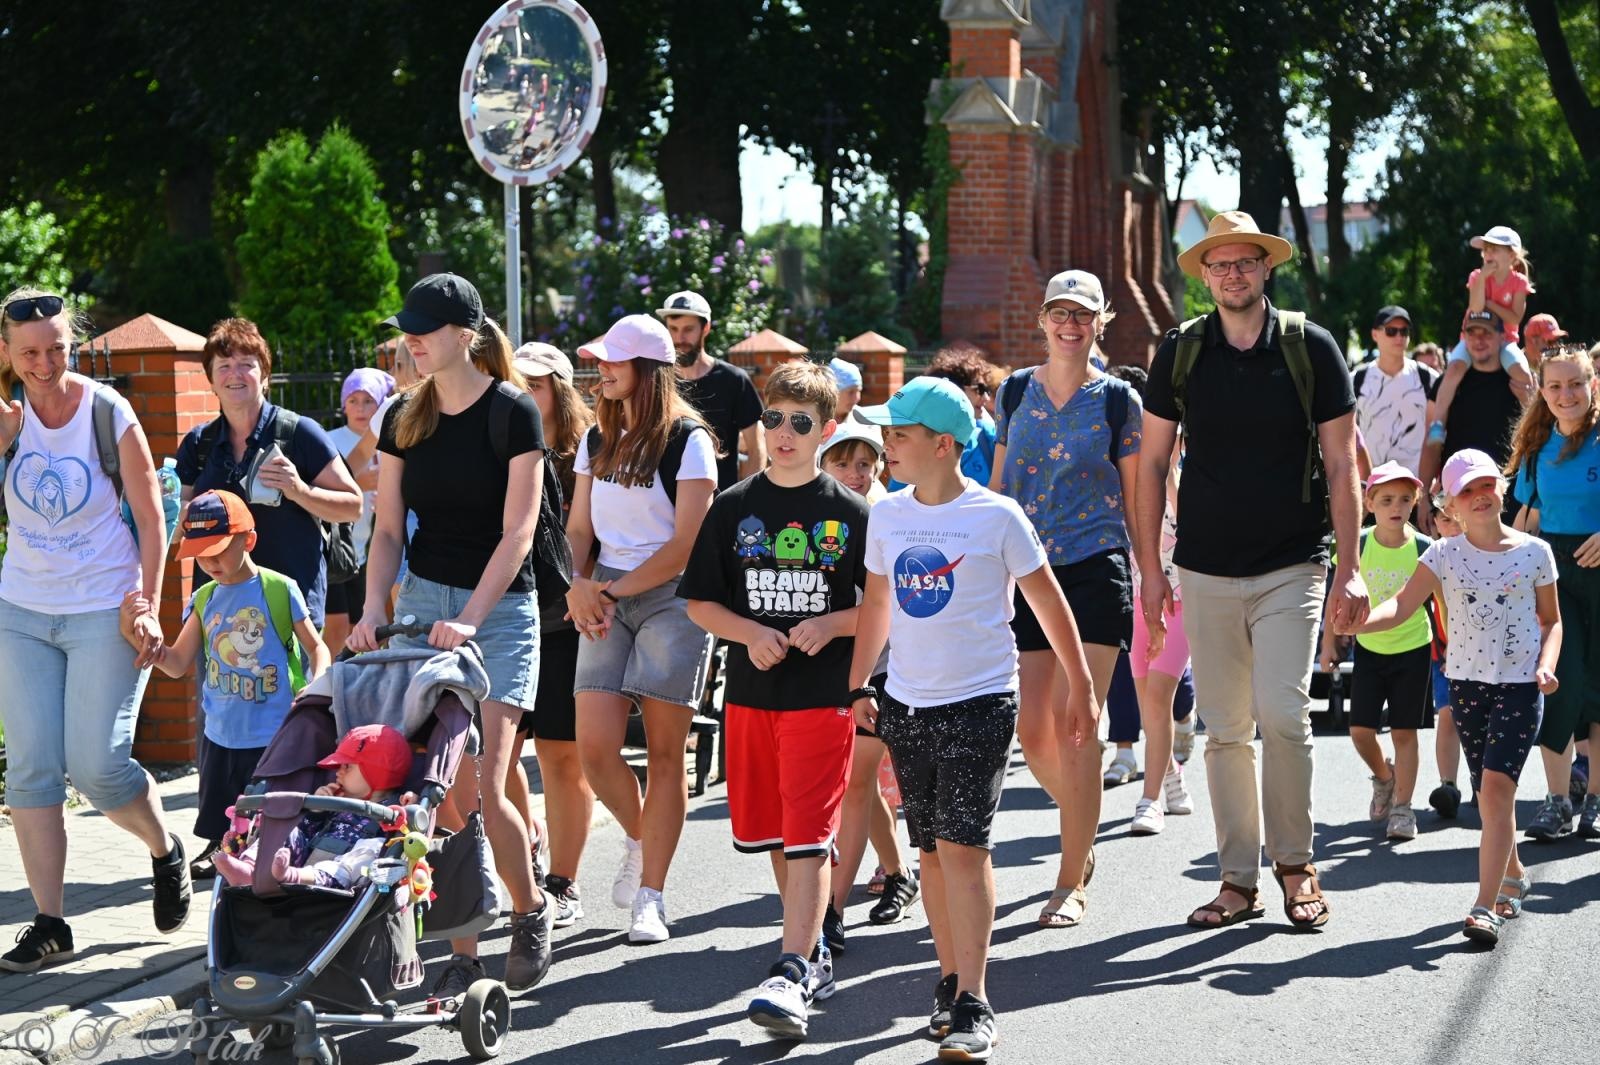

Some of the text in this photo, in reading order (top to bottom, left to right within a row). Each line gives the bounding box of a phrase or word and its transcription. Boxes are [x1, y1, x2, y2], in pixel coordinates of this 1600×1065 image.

[1586, 466, 1598, 482] 5
[746, 569, 829, 593] BRAWL
[897, 573, 951, 591] NASA
[748, 590, 826, 612] STARS
[207, 657, 278, 704] RUBBLE
